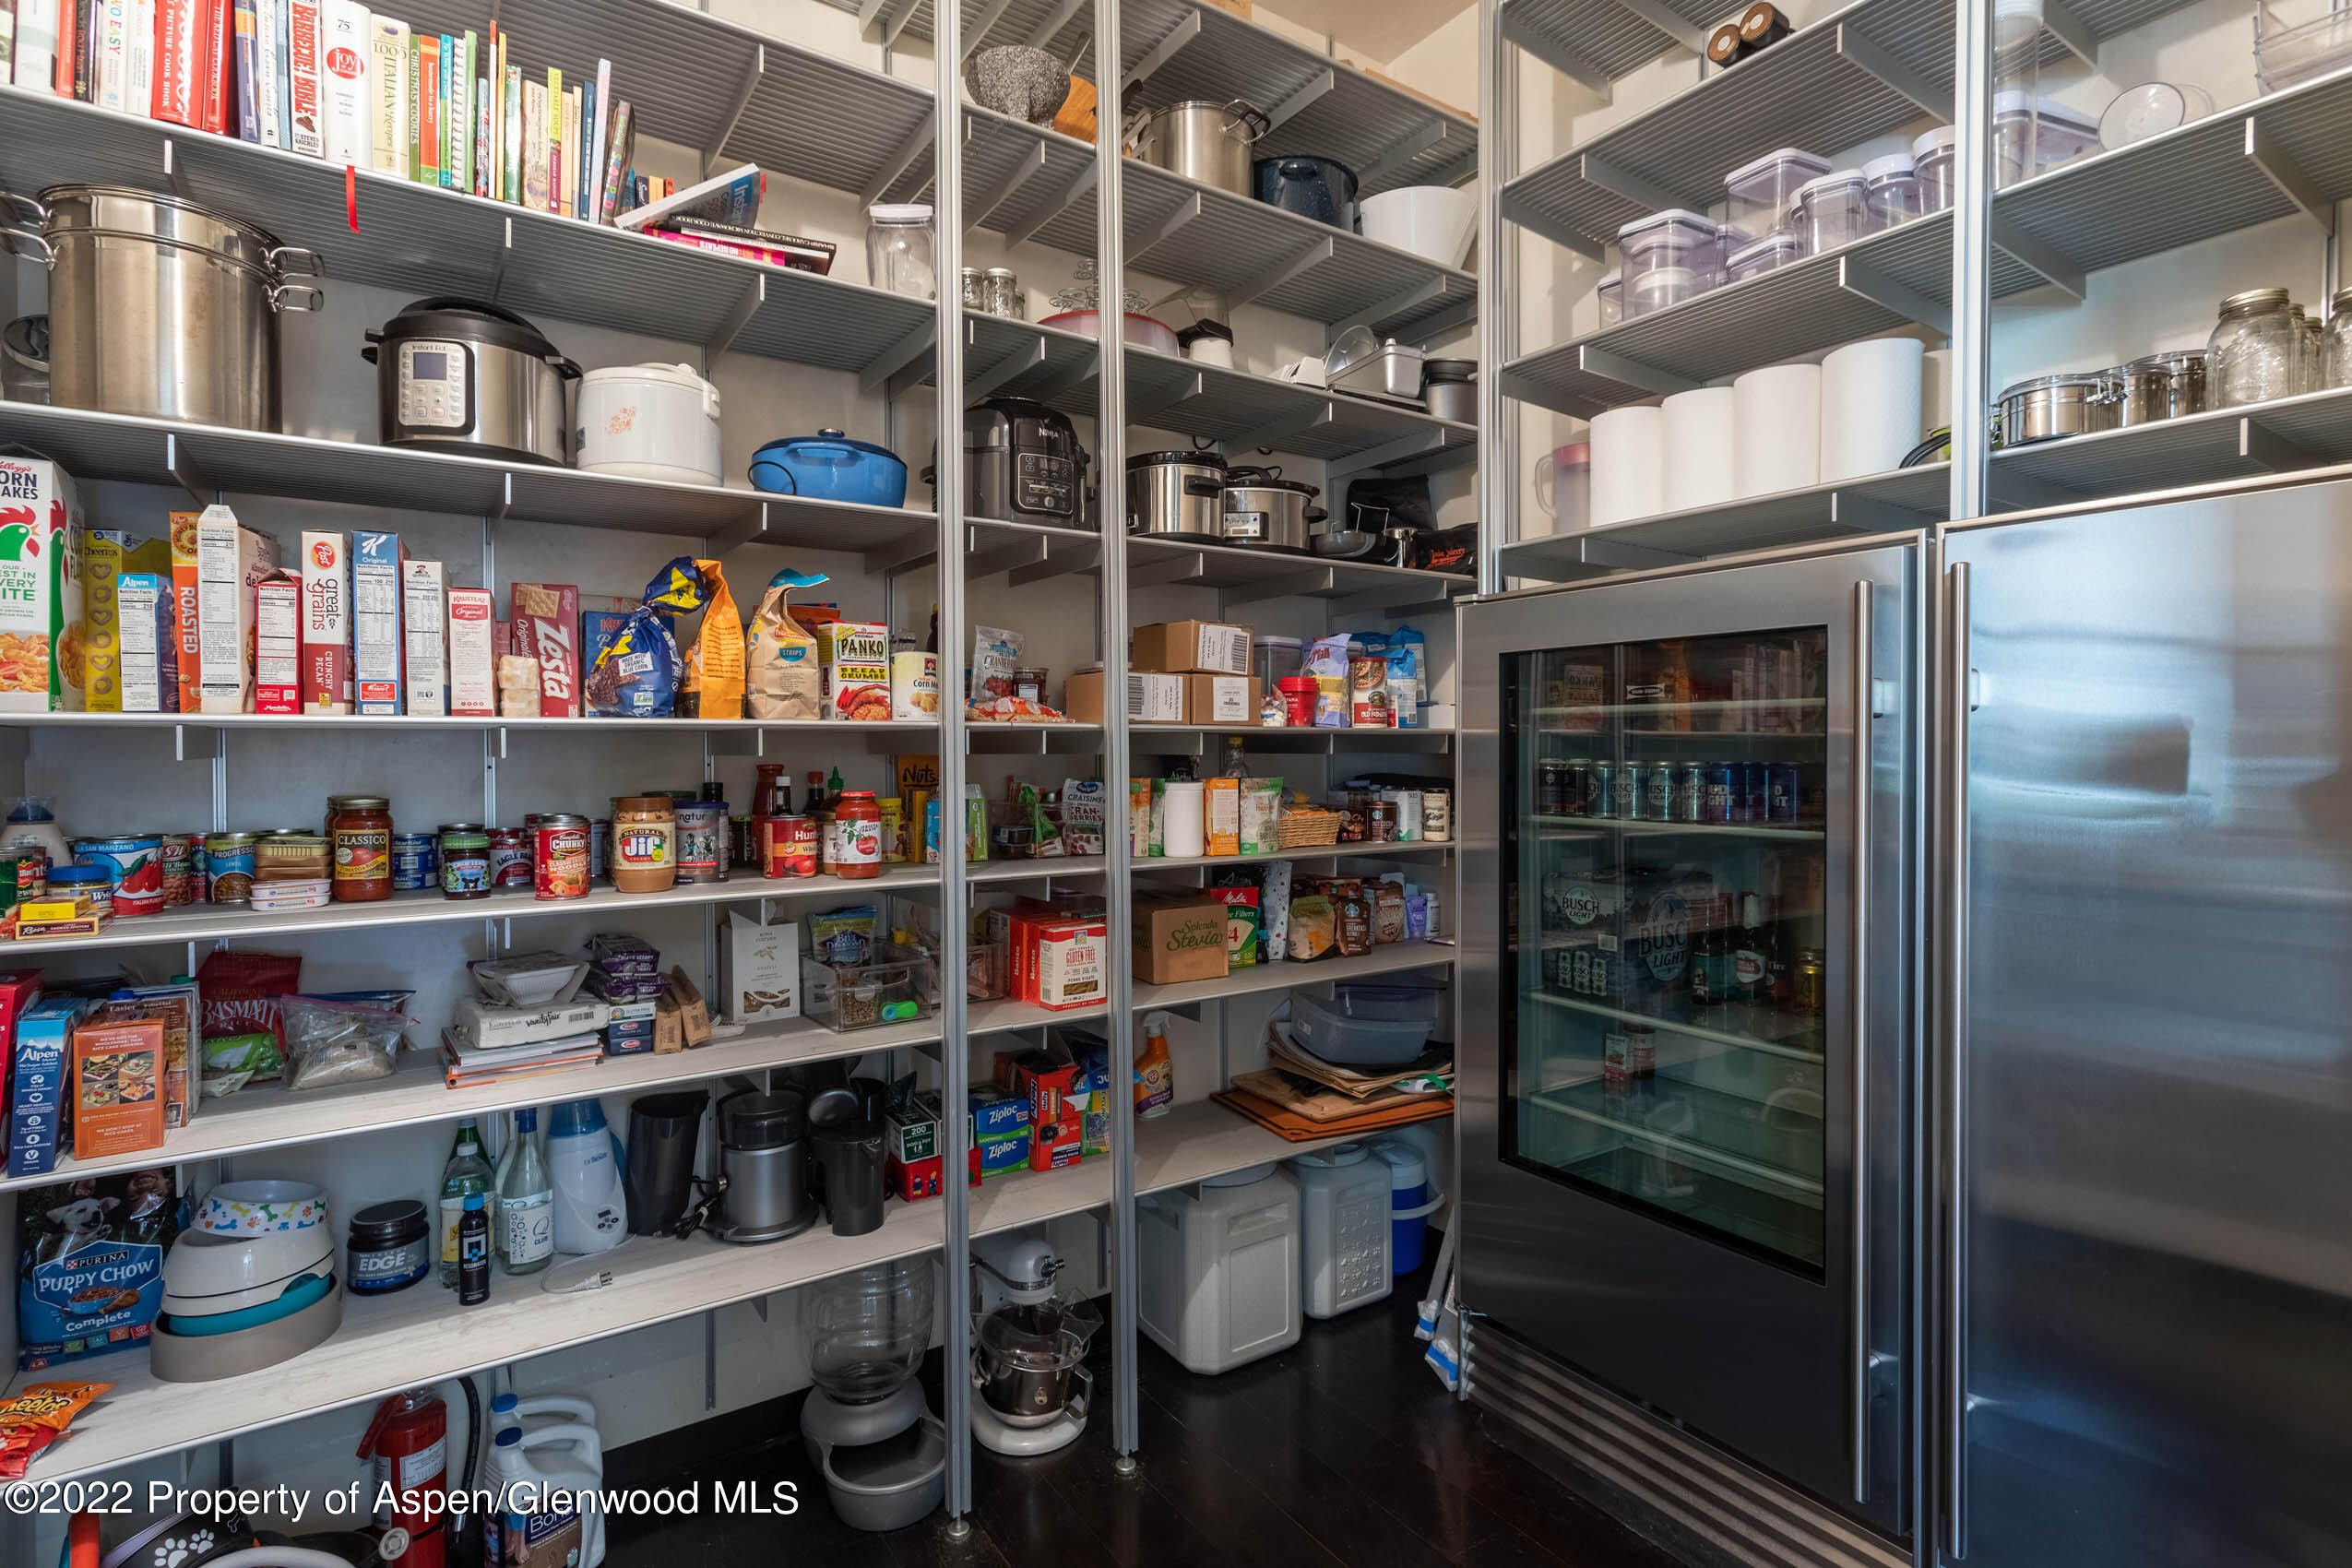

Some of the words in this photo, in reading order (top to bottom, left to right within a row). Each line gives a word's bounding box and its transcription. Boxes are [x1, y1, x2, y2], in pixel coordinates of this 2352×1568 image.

[110, 20, 122, 54] EASY
[165, 9, 174, 49] PICTURE
[291, 2, 317, 76] BARBECUE!
[163, 53, 172, 80] COOK
[336, 50, 355, 70] joy
[385, 56, 397, 111] ITALIAN
[410, 49, 420, 100] CHRISTMAS
[294, 75, 317, 117] BIBLE
[410, 102, 419, 144] COOKIES
[175, 526, 189, 542] HONEY
[316, 545, 330, 565] Post
[122, 576, 148, 588] Alpen
[306, 578, 326, 631] grains
[326, 578, 340, 622] great
[180, 587, 198, 654] ROASTED
[782, 648, 802, 657] STRIPS
[840, 638, 884, 656] PANKO
[534, 617, 569, 700] Zesta
[325, 650, 333, 690] CRUNCHY
[623, 666, 636, 674] BLUE
[636, 664, 648, 672] CORN
[339, 835, 386, 845] CLASSICO
[552, 838, 585, 849] CHUNKY
[624, 837, 661, 856] Jif
[497, 852, 518, 866] EAGLE
[1234, 910, 1255, 919] Filters
[1562, 897, 1599, 913] BUSCH
[1569, 910, 1592, 920] LIGHT
[1182, 920, 1218, 933] Splenda
[1167, 929, 1223, 952] Stevia
[1066, 950, 1084, 963] GLUTEN
[1085, 949, 1096, 961] FREE
[109, 1004, 137, 1013] Easier
[202, 999, 274, 1029] BASMATI
[18, 1048, 58, 1063] Alpen
[989, 1104, 1017, 1124] Ziploc
[911, 1125, 927, 1135] 200
[989, 1140, 1017, 1159] Ziploc
[534, 1237, 549, 1245] CLUB
[79, 1253, 125, 1266] PURINA
[359, 1252, 406, 1271] EDGE
[39, 1272, 96, 1292] PUPPY
[101, 1259, 154, 1282] CHOW
[65, 1311, 131, 1332] Complete
